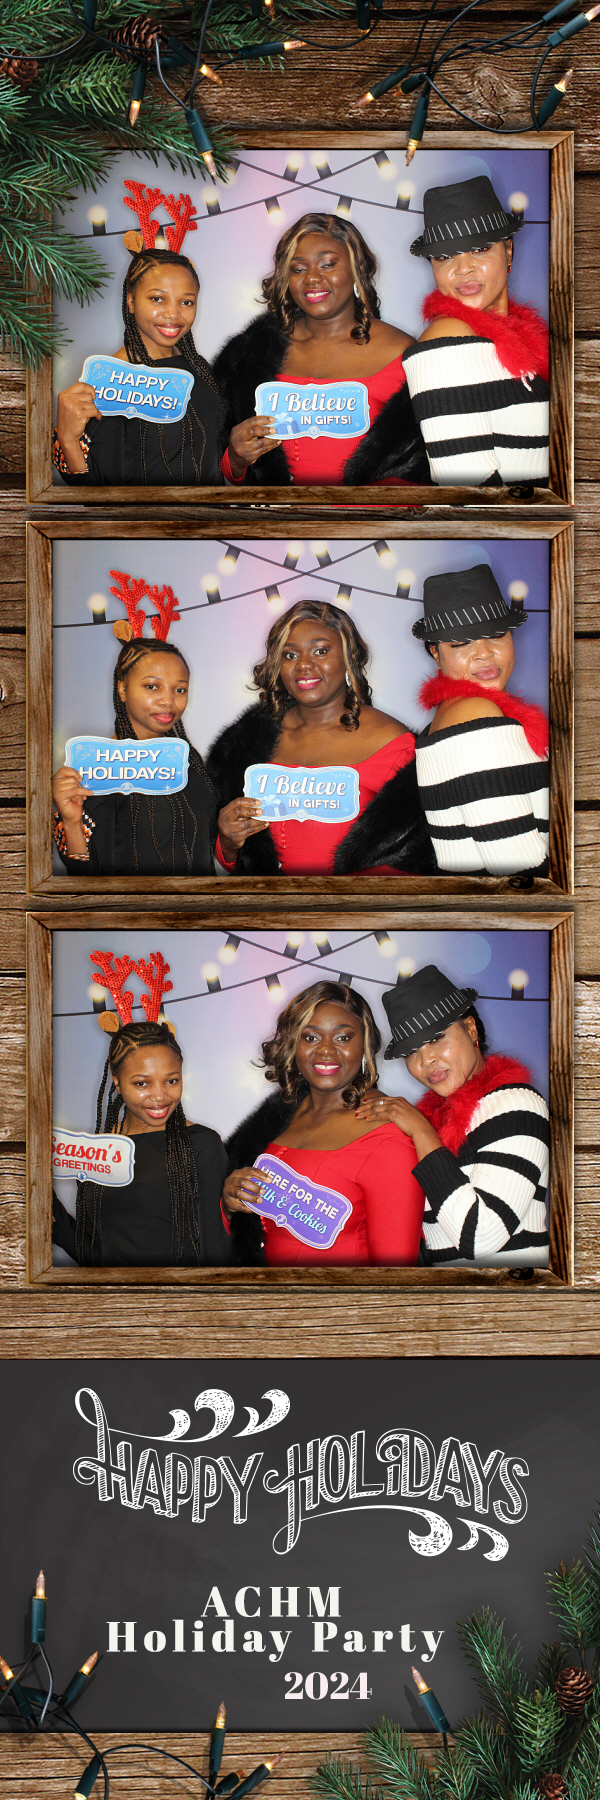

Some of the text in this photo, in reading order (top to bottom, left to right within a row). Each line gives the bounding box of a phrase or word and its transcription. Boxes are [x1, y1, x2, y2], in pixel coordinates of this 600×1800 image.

[109, 370, 169, 391] HAPPY
[93, 385, 178, 410] HOLIDAYS!
[268, 392, 357, 412] I Believe
[300, 415, 352, 425] IN GIFTS!
[96, 749, 161, 763] HAPPY
[79, 766, 176, 780] HOLIDAYS!
[257, 774, 347, 796] I Believe
[288, 798, 341, 809] IN GIFTS!
[53, 1157, 112, 1174] GREETINGS
[288, 1183, 313, 1206] FOR
[314, 1198, 340, 1220] THE
[276, 1196, 288, 1209] &
[288, 1203, 328, 1235] Cookies
